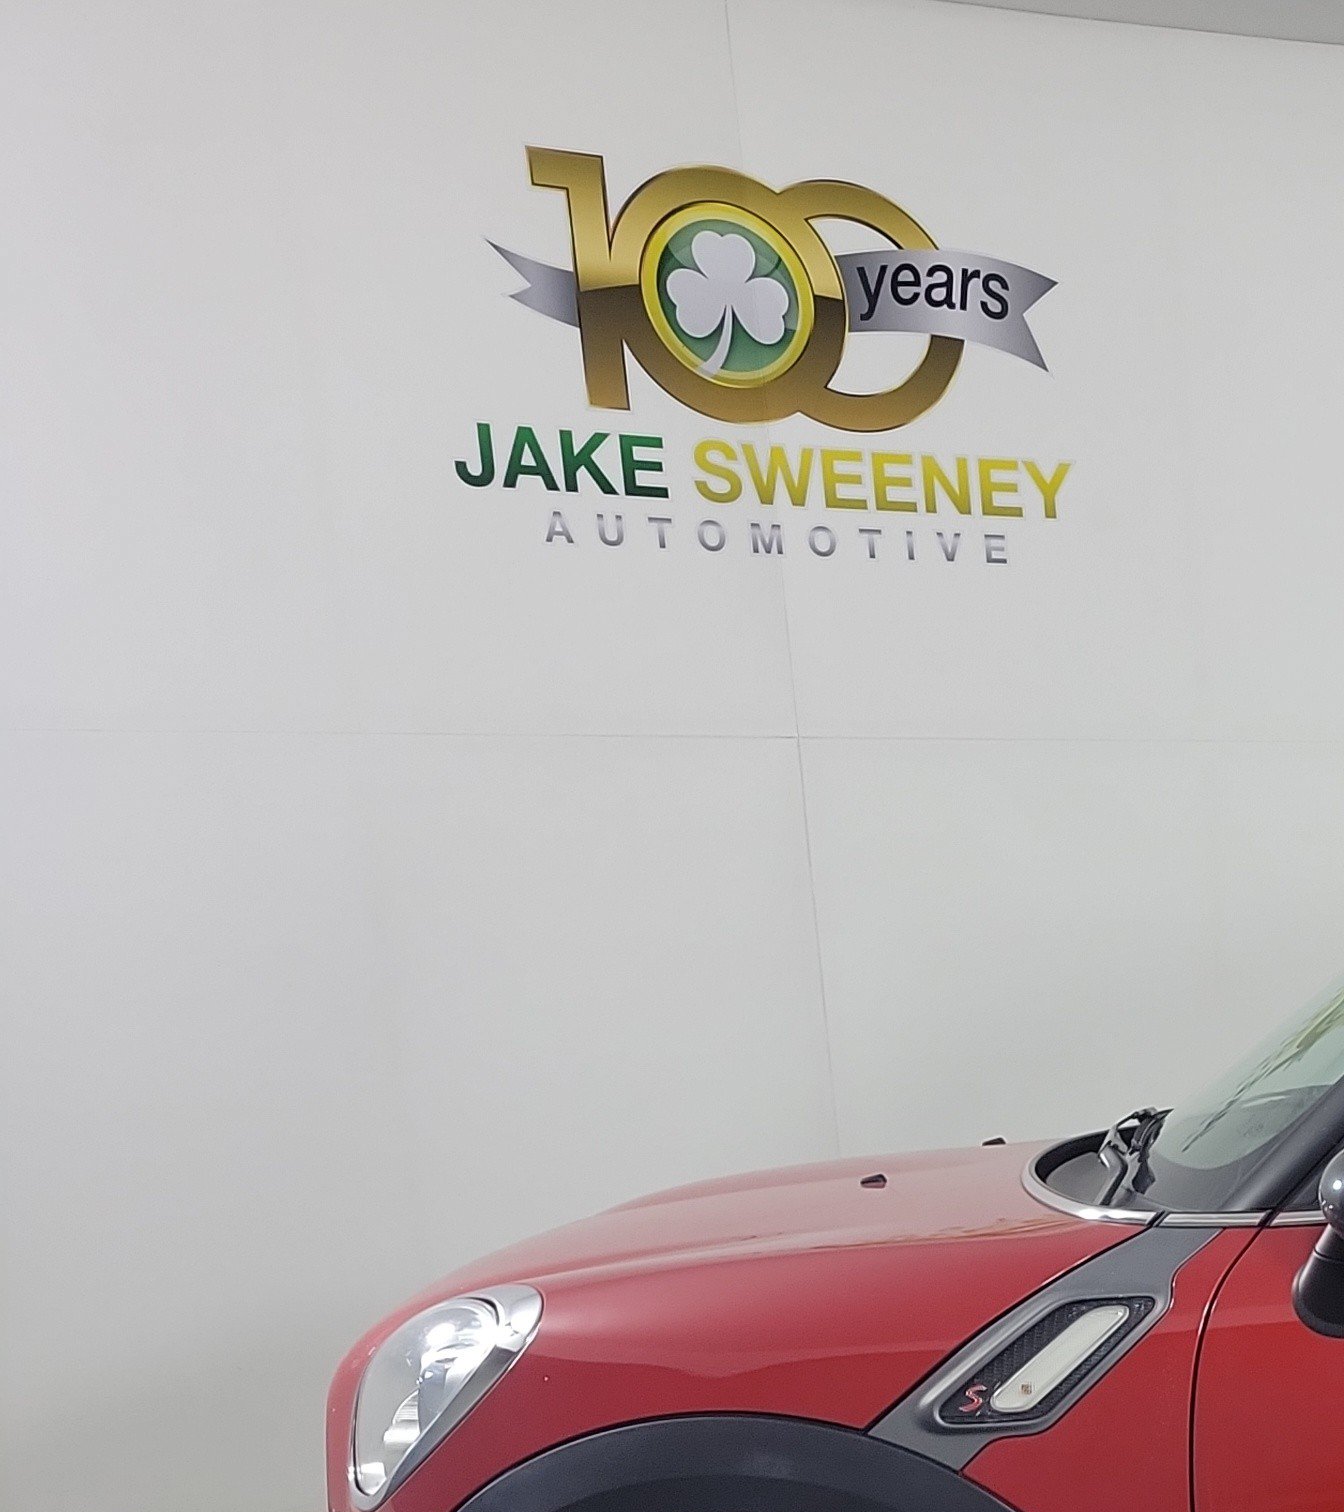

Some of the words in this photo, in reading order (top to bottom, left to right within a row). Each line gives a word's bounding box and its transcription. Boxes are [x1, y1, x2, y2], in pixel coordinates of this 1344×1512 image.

[525, 145, 965, 433] 100
[857, 261, 1010, 323] years
[454, 422, 669, 498] JAKE
[693, 440, 1072, 519] SWEENEY
[545, 511, 1009, 564] AUTOMOTIVE
